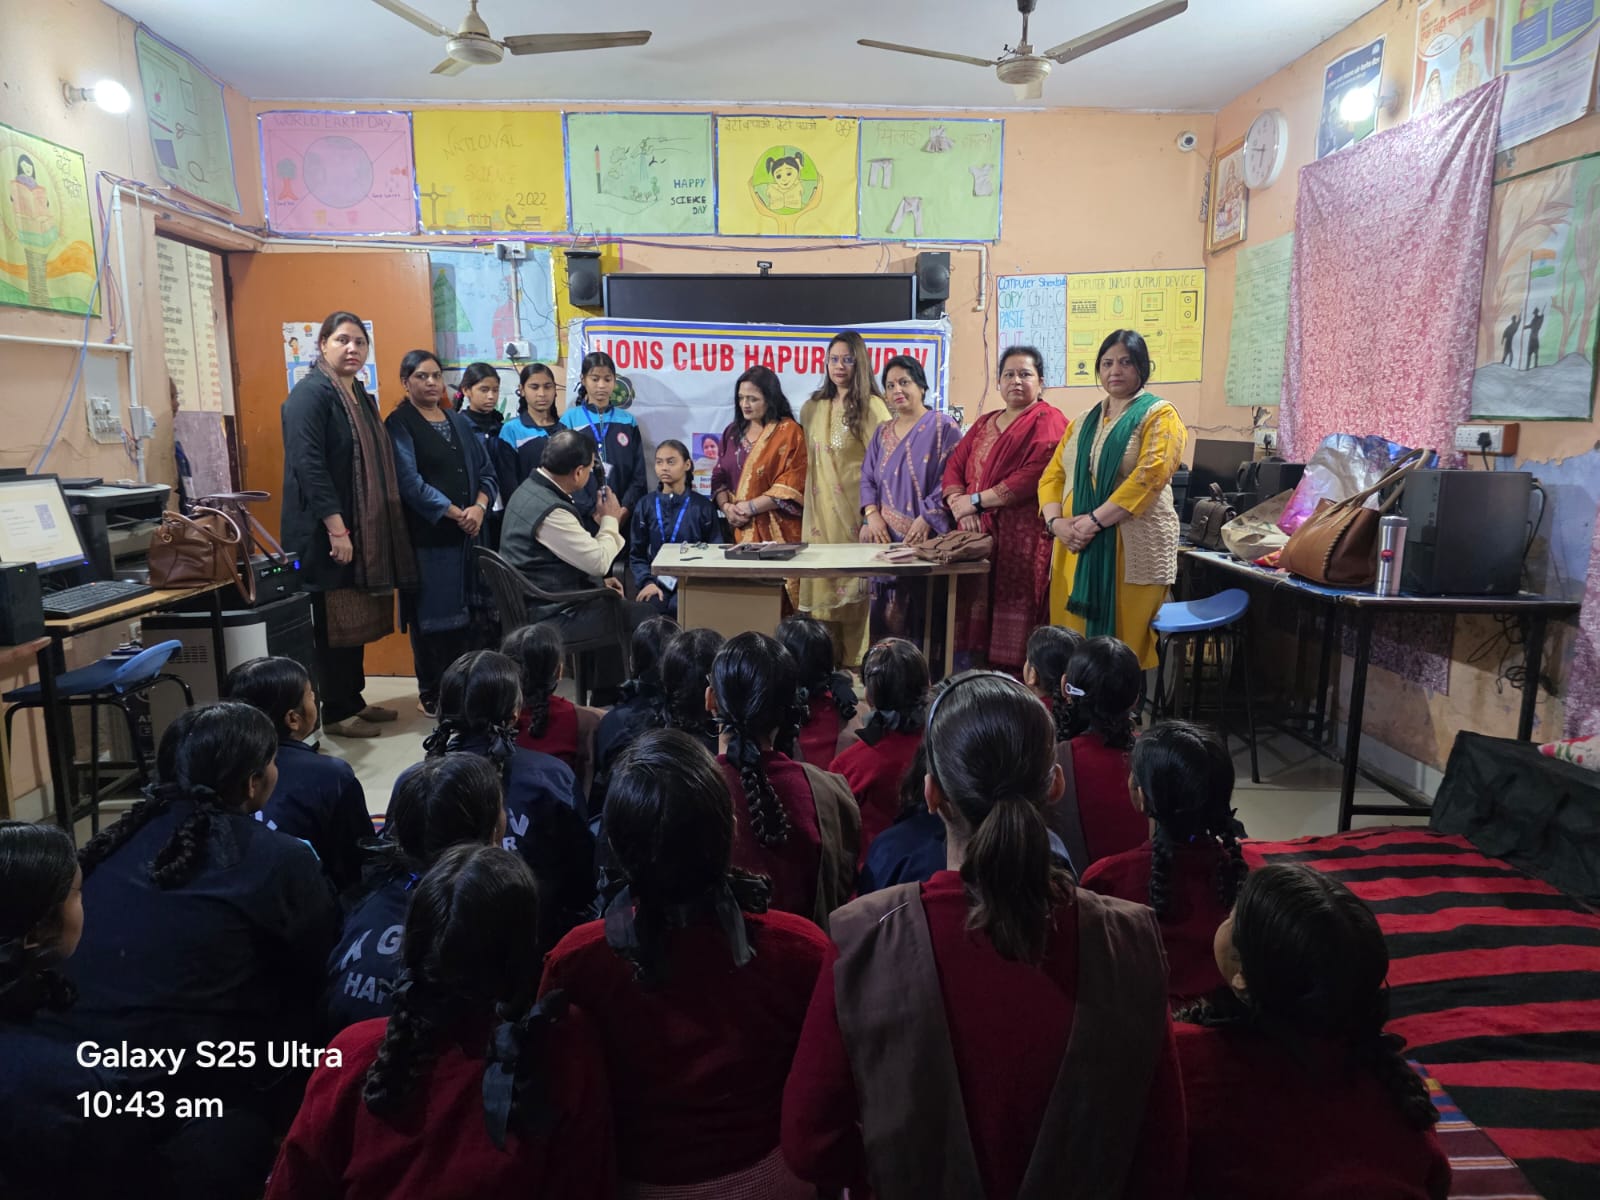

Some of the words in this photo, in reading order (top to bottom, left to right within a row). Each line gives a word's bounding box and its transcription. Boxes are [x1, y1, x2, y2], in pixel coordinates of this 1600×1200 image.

[275, 115, 320, 128] WORLD
[325, 115, 364, 128] EARTH
[368, 115, 392, 128] DAY
[673, 179, 706, 189] HAPPY
[516, 192, 547, 207] 2022
[671, 196, 707, 206] SCIENCE
[692, 205, 707, 215] DAY
[1109, 276, 1131, 289] INPUT
[1134, 276, 1162, 289] OUTPUT
[1165, 274, 1197, 288] DEVICE
[999, 290, 1024, 309] COPY
[1000, 310, 1025, 329] PASTE
[673, 341, 735, 372] CLUB
[744, 344, 826, 375] HAPUR
